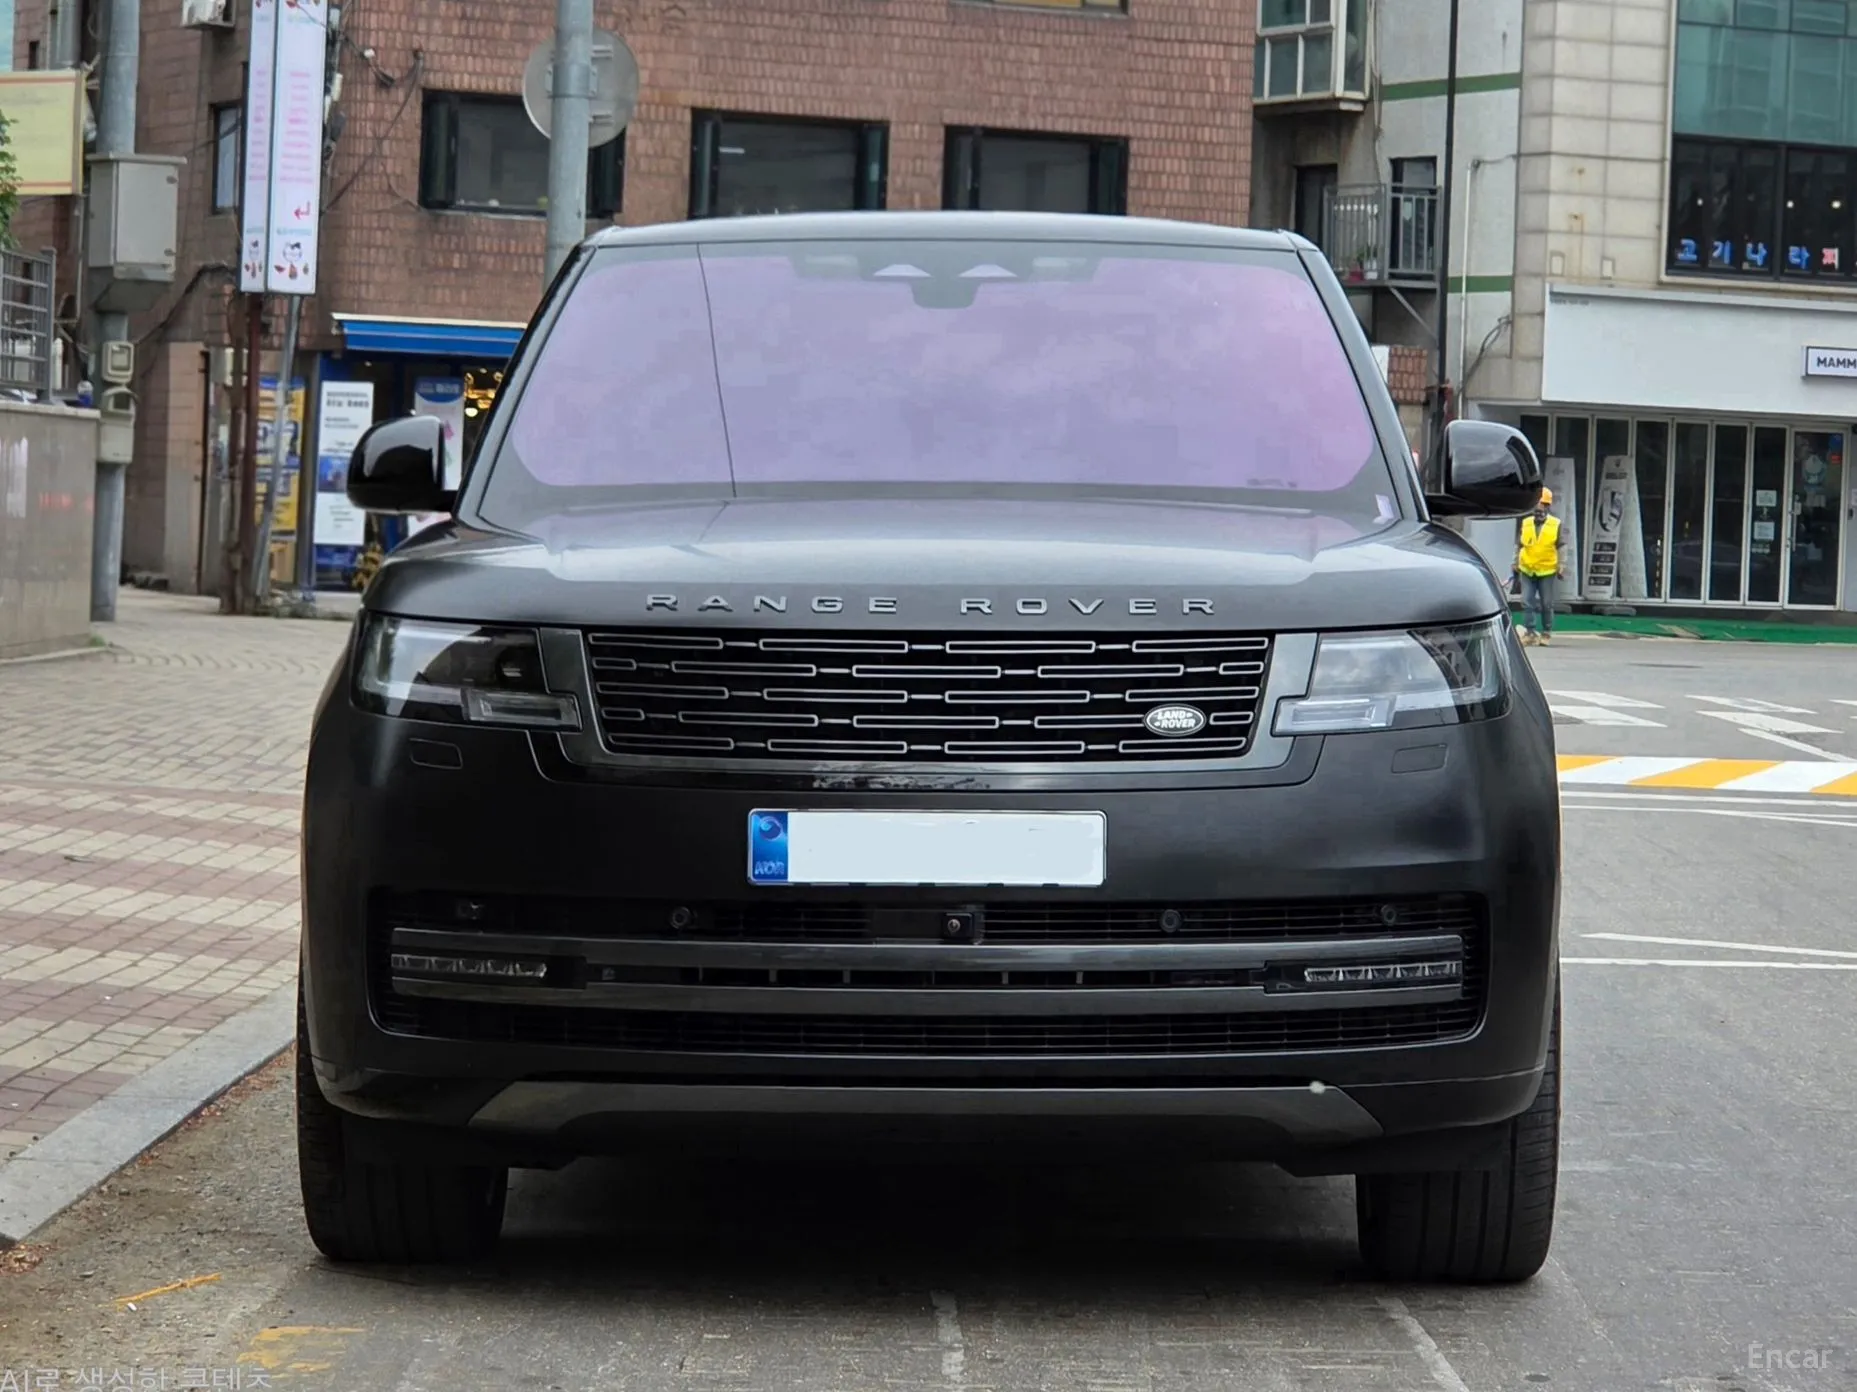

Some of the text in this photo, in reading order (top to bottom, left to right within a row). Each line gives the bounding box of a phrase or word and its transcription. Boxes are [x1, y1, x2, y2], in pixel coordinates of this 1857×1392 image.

[646, 594, 1215, 615] RANGE ROVER
[1157, 710, 1186, 720] LAND
[1161, 718, 1196, 729] ROVER
